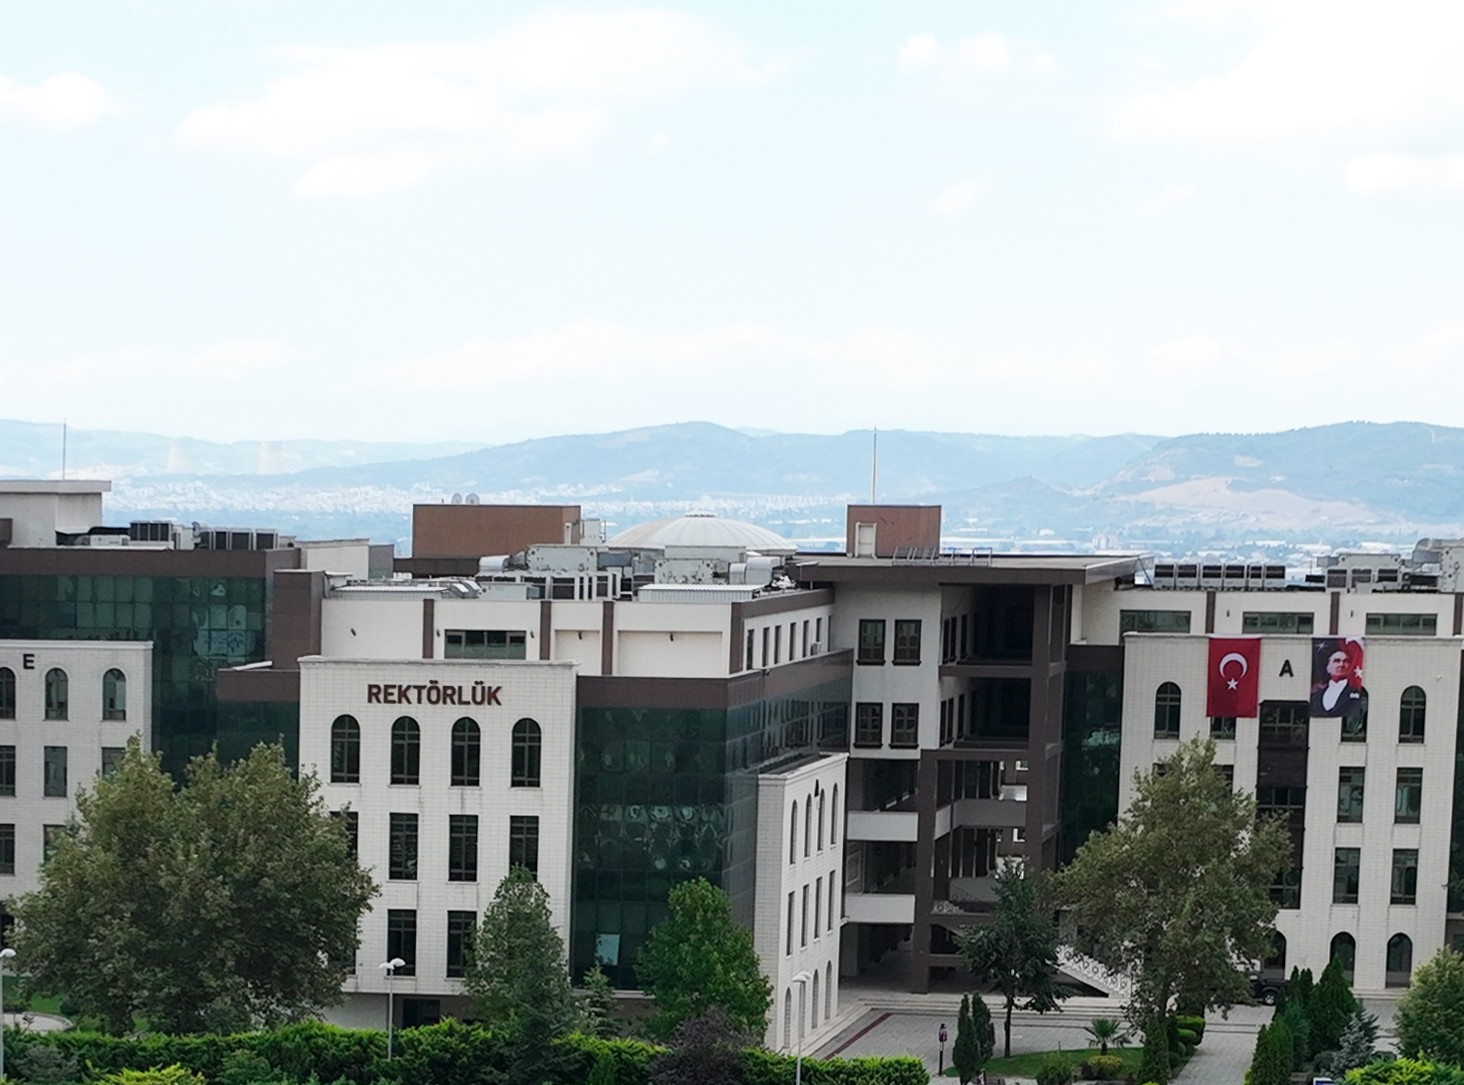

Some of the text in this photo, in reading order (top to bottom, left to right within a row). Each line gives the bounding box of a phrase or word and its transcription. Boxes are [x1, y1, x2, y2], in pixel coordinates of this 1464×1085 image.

[22, 653, 36, 670] E
[1278, 659, 1294, 678] A
[367, 679, 502, 706] REKTÖRLÜK
